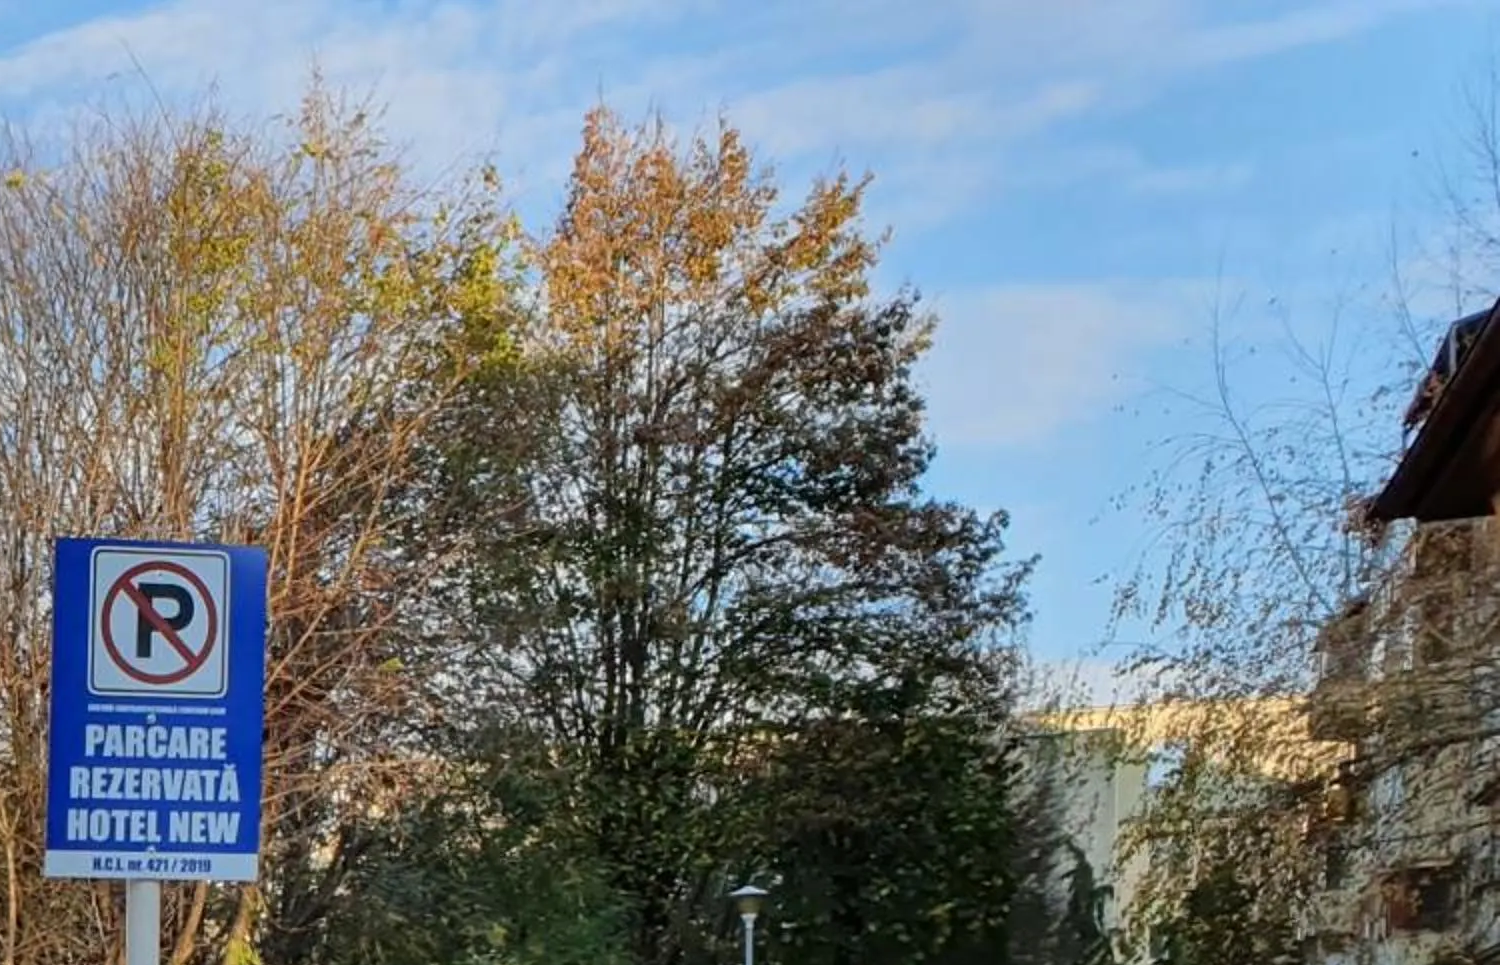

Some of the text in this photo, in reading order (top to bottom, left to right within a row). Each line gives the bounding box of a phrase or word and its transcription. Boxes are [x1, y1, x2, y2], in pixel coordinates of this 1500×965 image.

[136, 582, 196, 659] P
[84, 723, 228, 760] PARCARE
[69, 764, 240, 802] REZERVATĂ
[67, 809, 241, 844] HOTEL NEW
